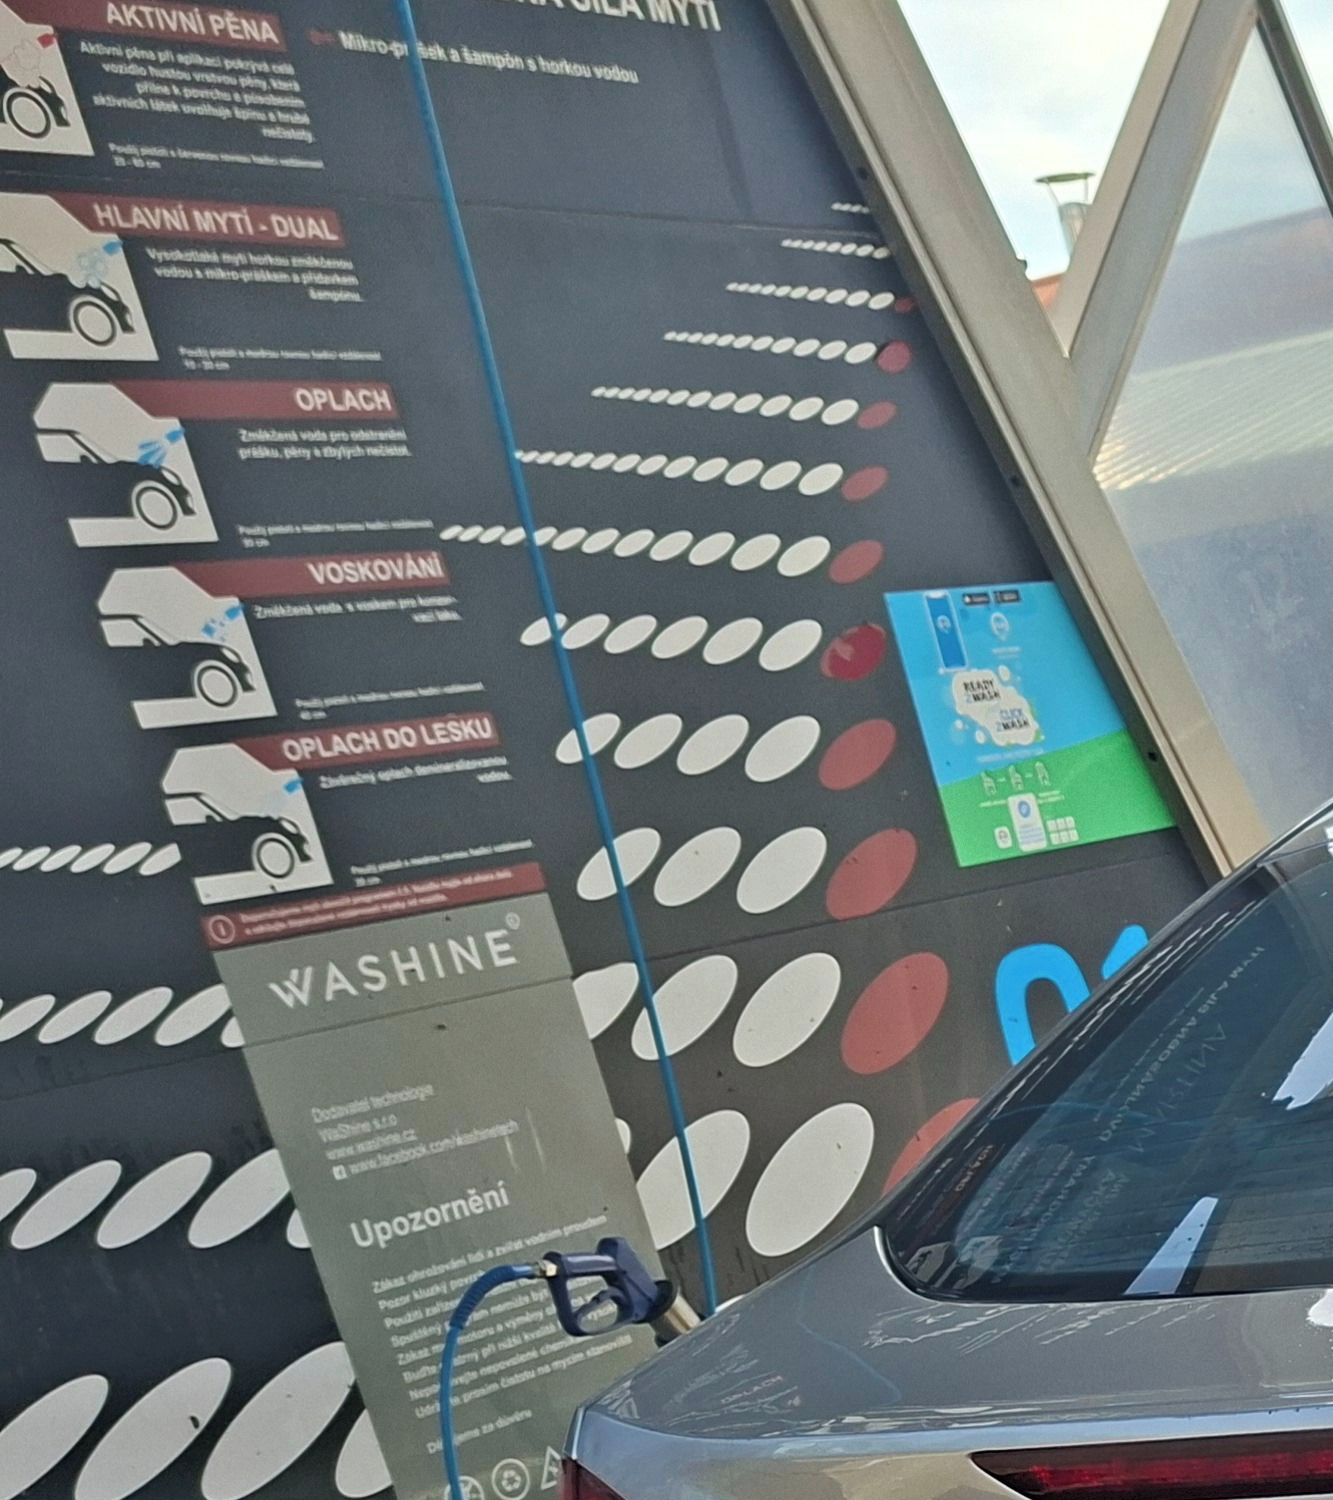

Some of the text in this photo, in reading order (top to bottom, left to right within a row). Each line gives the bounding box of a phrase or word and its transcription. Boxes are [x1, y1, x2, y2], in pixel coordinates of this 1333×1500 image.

[106, 2, 279, 44] AKTIVNÍ PĚNA
[339, 30, 447, 62] Mikro-pršek
[94, 204, 188, 232] HLAVNÍ
[193, 207, 254, 236] MYTÍ
[271, 214, 339, 241] DUAL
[295, 388, 392, 411] OPLACH
[307, 551, 445, 585] VOSKOVÁNÍ
[283, 718, 494, 762] OPLACH DO LESKU
[268, 928, 519, 1009] WASHINE
[350, 1180, 510, 1248] Upozornění
